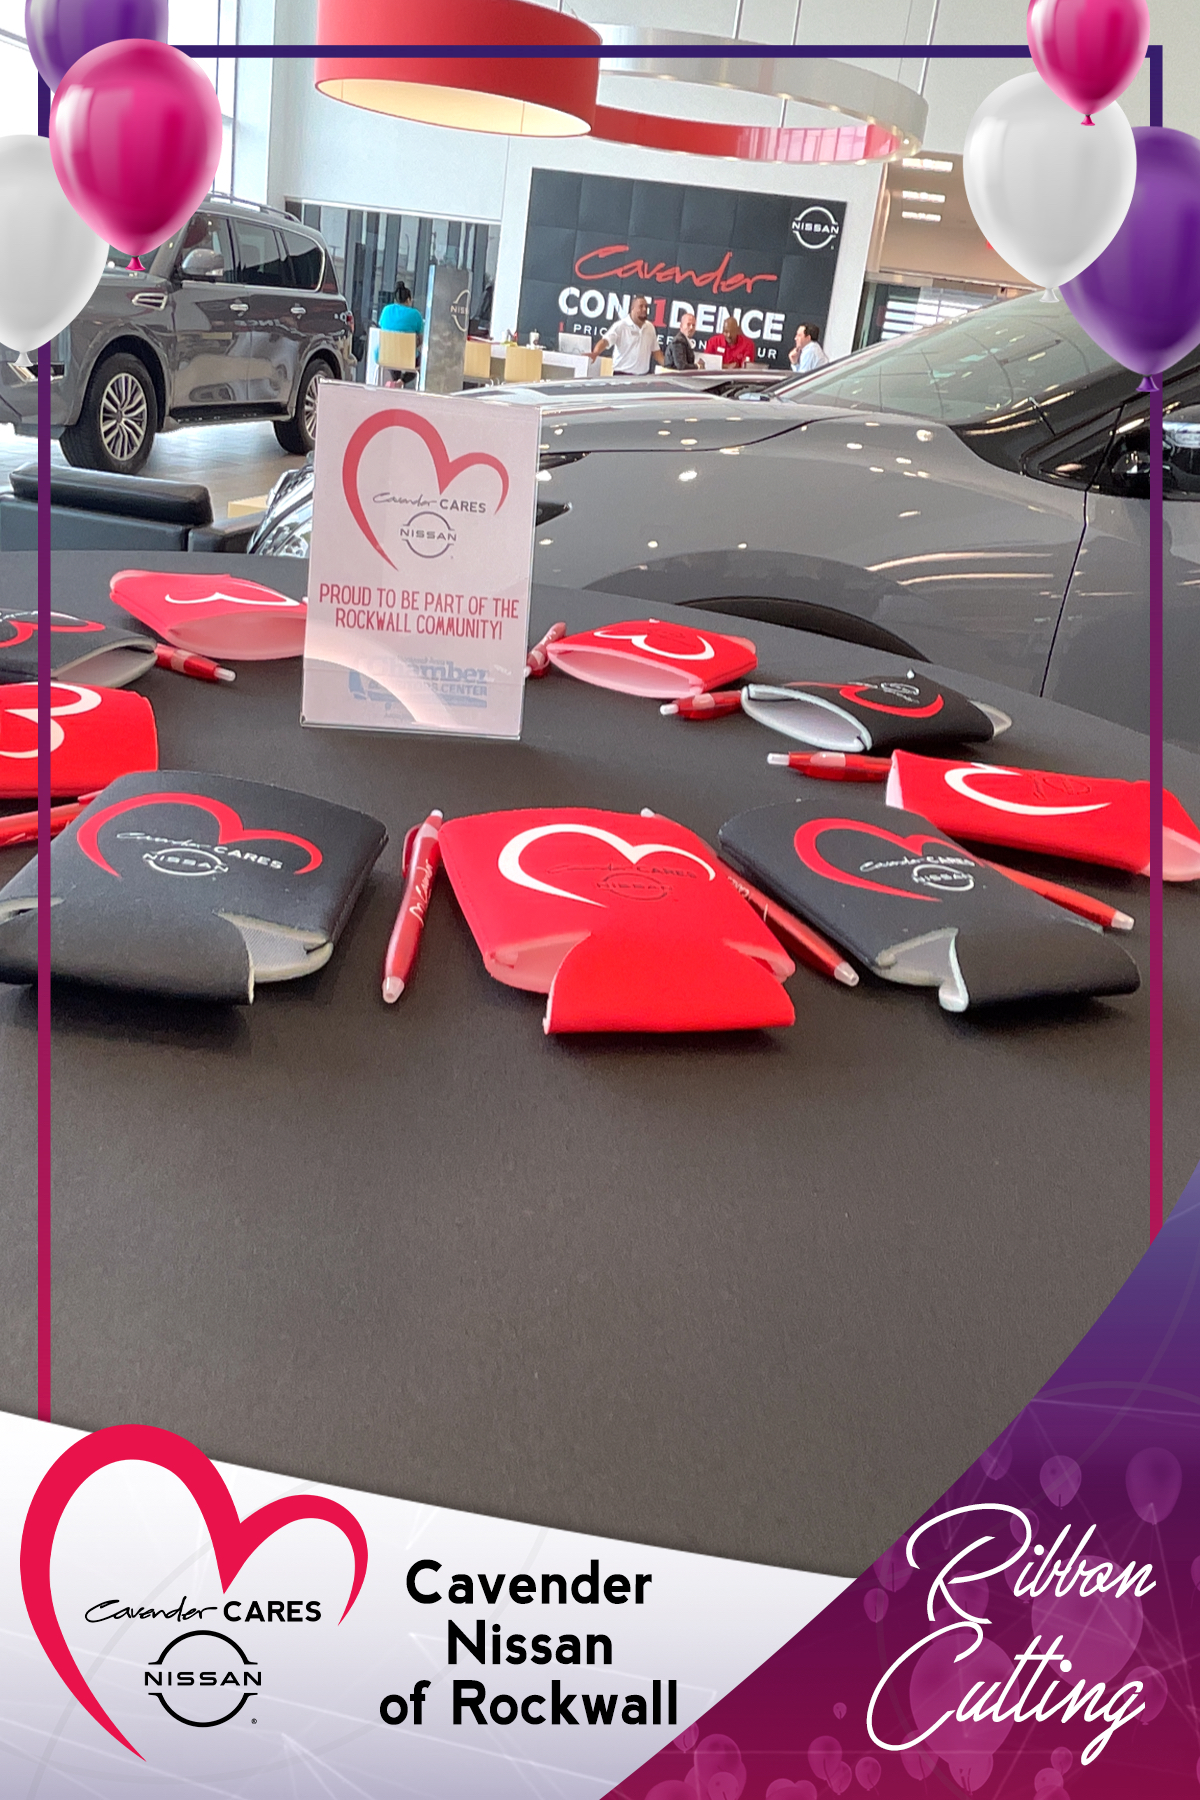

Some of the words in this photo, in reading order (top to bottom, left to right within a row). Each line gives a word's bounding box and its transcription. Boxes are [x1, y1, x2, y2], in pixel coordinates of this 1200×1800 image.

[792, 221, 839, 234] NISSAN
[575, 245, 777, 294] Cavender
[440, 499, 486, 513] CARES
[400, 529, 456, 541] NISSAN
[319, 583, 372, 607] PROUD
[377, 588, 396, 608] TO
[401, 590, 420, 611] BE
[424, 592, 464, 614] PART
[468, 595, 488, 616] OF
[492, 597, 519, 618] THE
[335, 607, 411, 633] ROCKWALL
[142, 852, 229, 873] NISSAN
[213, 846, 283, 869] CARES
